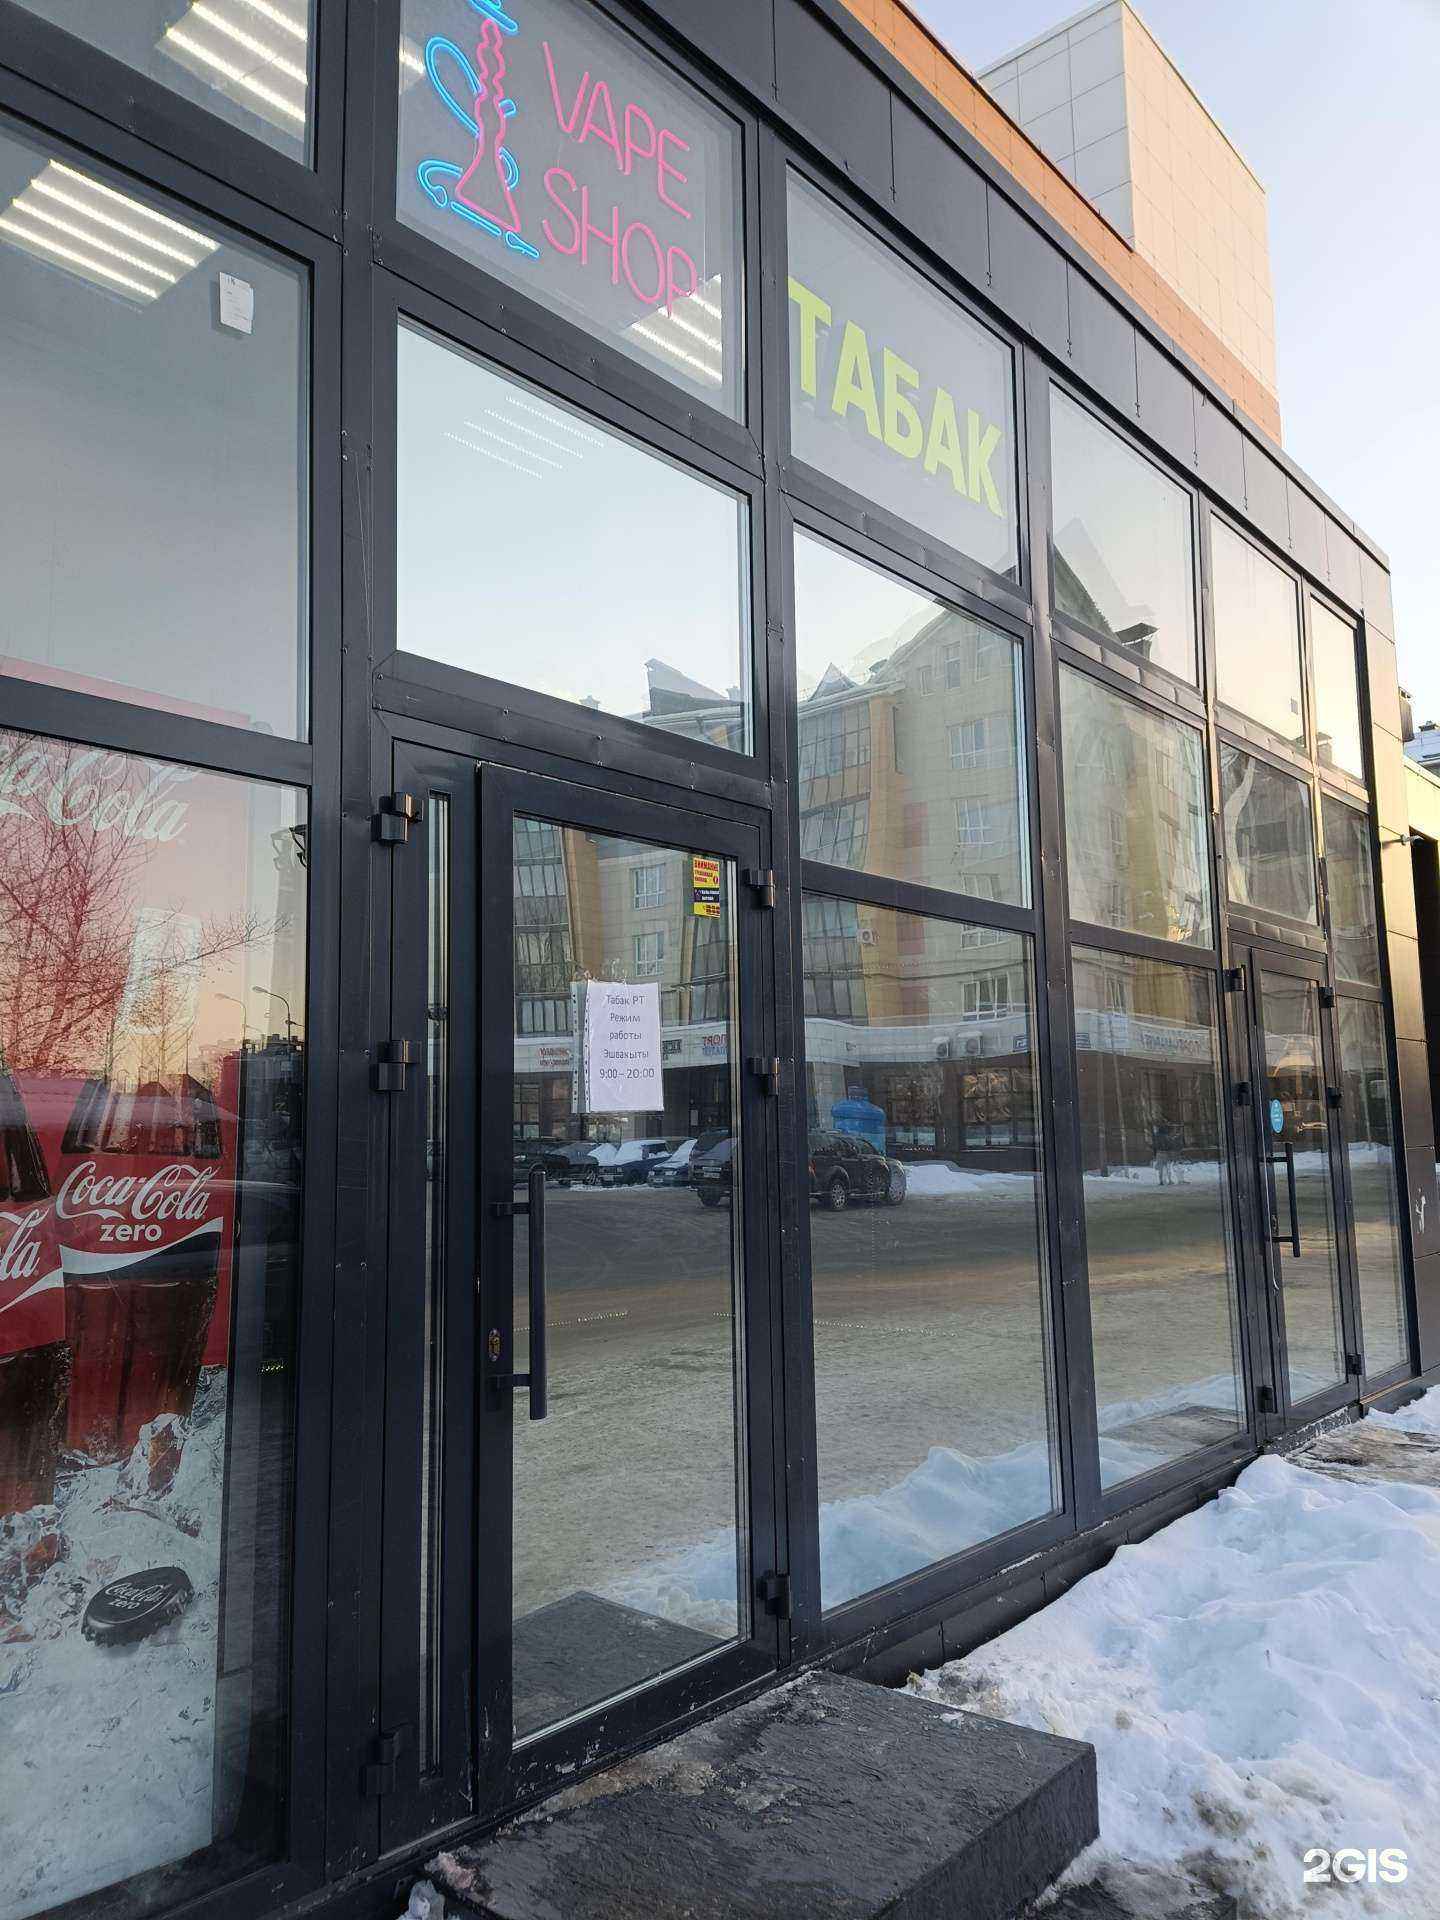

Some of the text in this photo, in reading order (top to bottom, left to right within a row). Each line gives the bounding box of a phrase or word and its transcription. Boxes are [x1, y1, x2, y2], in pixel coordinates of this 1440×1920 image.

[542, 41, 693, 220] VAPE
[542, 167, 698, 319] SHOP
[788, 276, 1005, 518] ТАБАК
[606, 994, 646, 1005] Табак РТ
[610, 1012, 641, 1023] Режим
[609, 1031, 642, 1041] работы
[99, 1221, 163, 1242] zero
